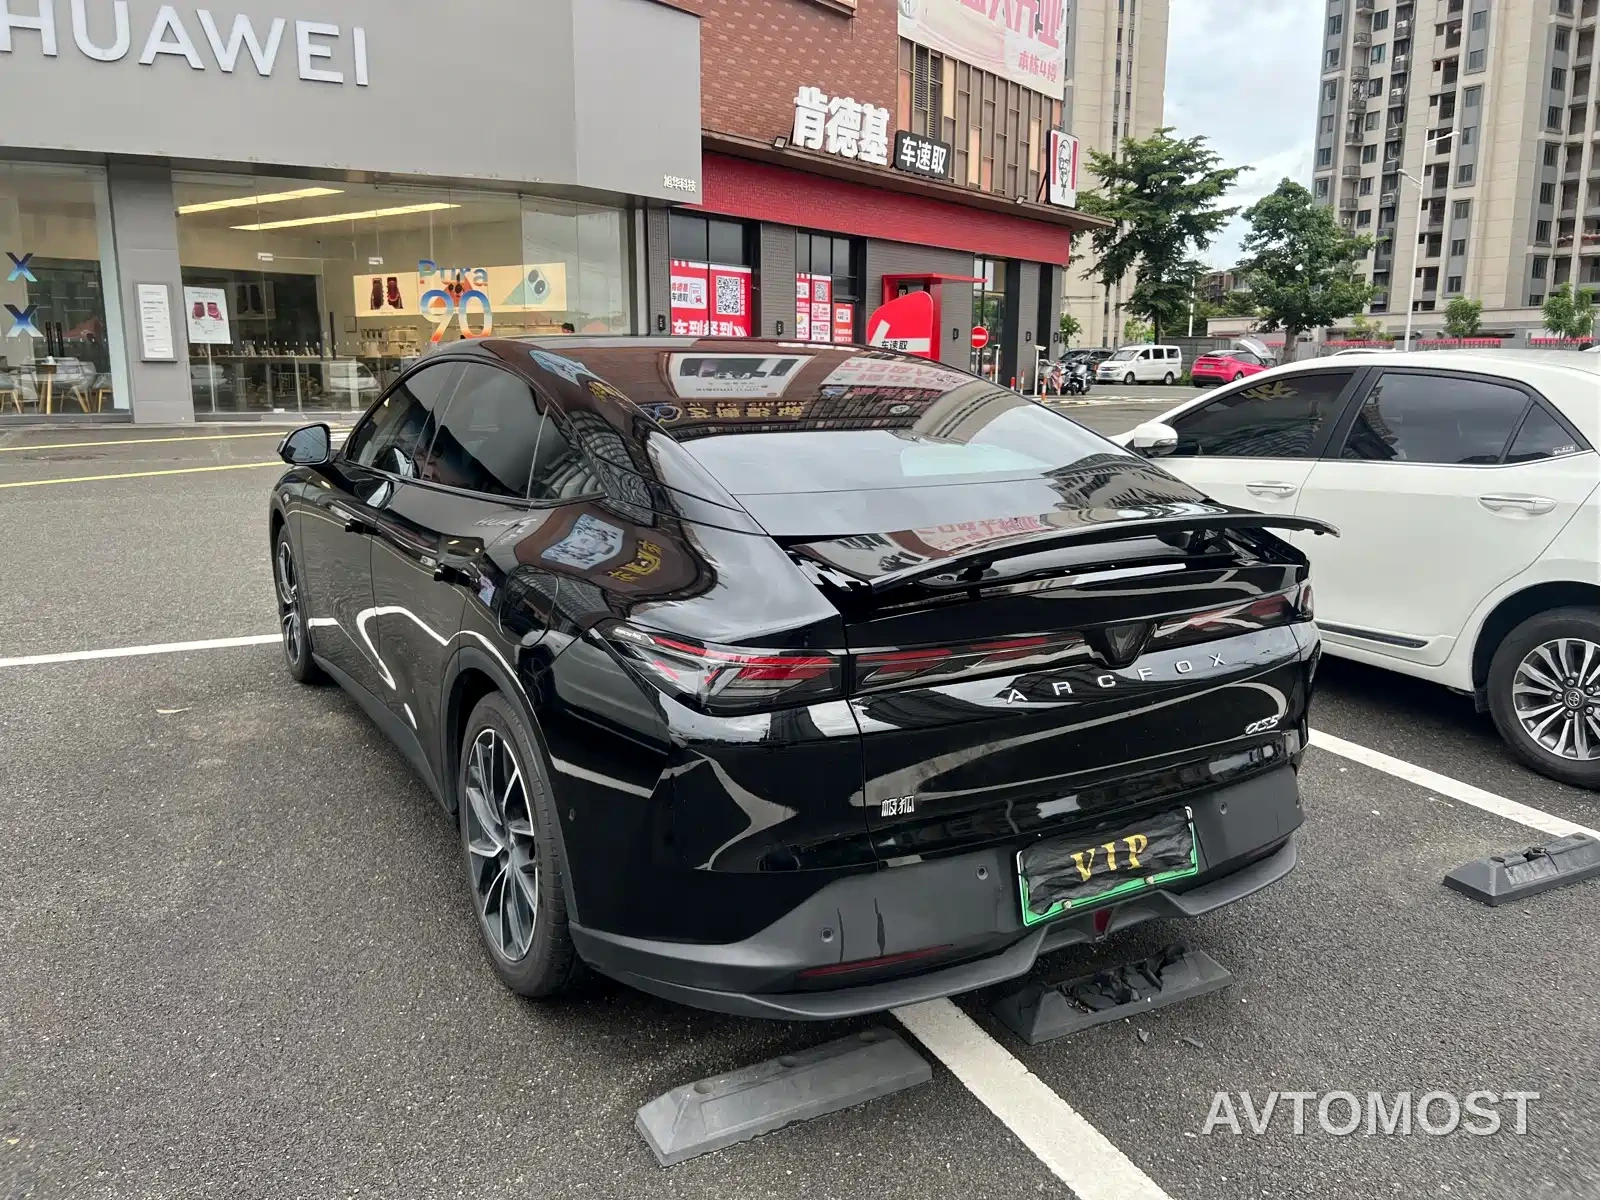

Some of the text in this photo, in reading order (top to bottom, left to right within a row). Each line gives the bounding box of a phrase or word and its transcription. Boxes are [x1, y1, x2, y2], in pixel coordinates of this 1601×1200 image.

[0, 0, 369, 86] HUAWEI
[1018, 50, 1058, 84] 本栋4楼
[793, 86, 890, 166] 肯德基
[900, 136, 948, 174] 车速取
[663, 174, 697, 193] 旭华科技
[5, 252, 38, 282] X
[418, 259, 489, 287] Pura
[3, 303, 44, 338] X
[420, 289, 493, 343] 90
[881, 340, 909, 351] 车速取
[1006, 652, 1227, 705] ARCFOX
[1069, 833, 1148, 882] VIP
